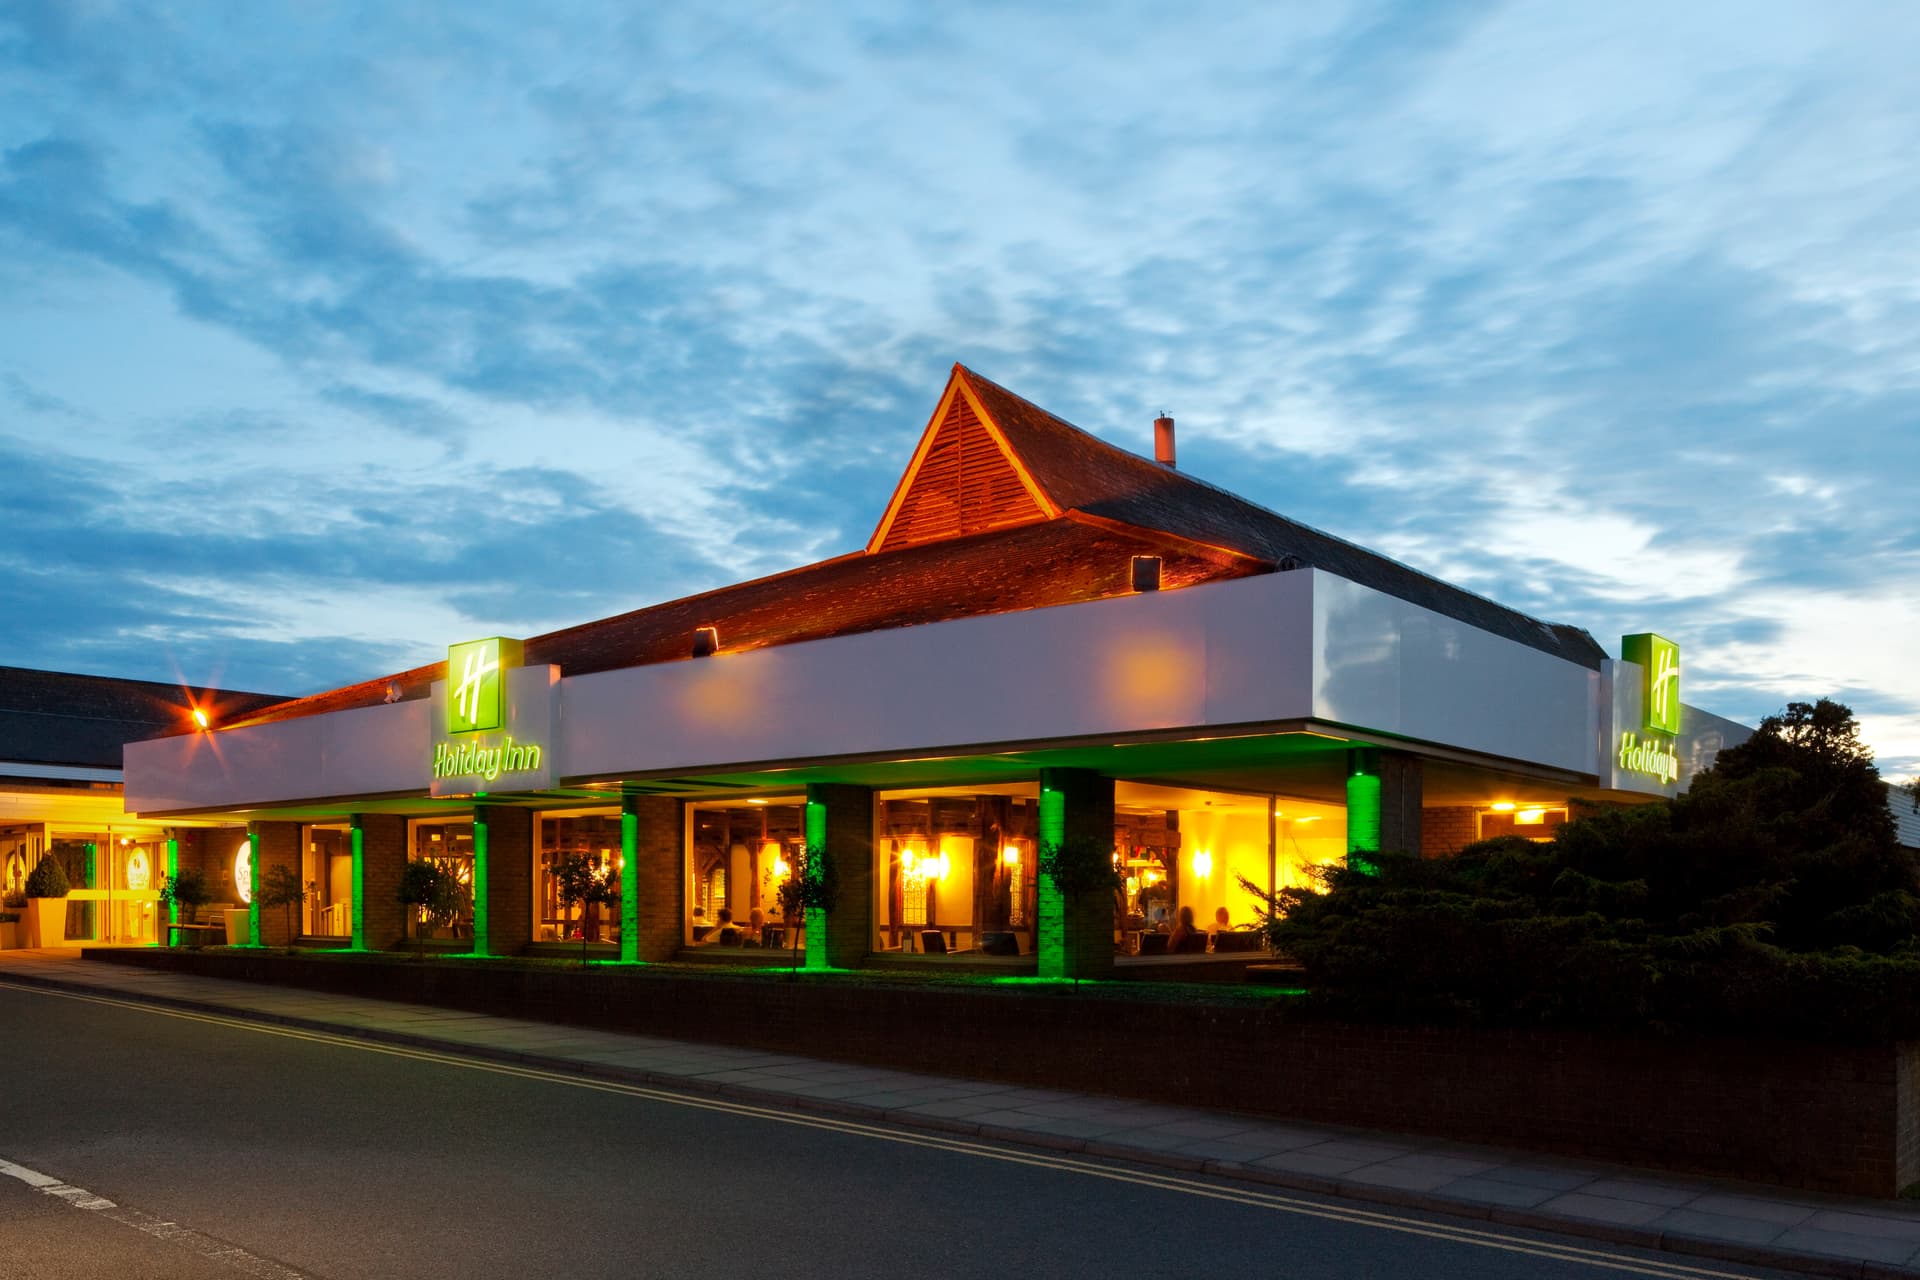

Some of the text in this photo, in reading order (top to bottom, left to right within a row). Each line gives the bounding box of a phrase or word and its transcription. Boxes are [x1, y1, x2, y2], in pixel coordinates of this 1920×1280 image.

[434, 736, 541, 781] Holiday Inn
[1618, 732, 1669, 785] Holiday
